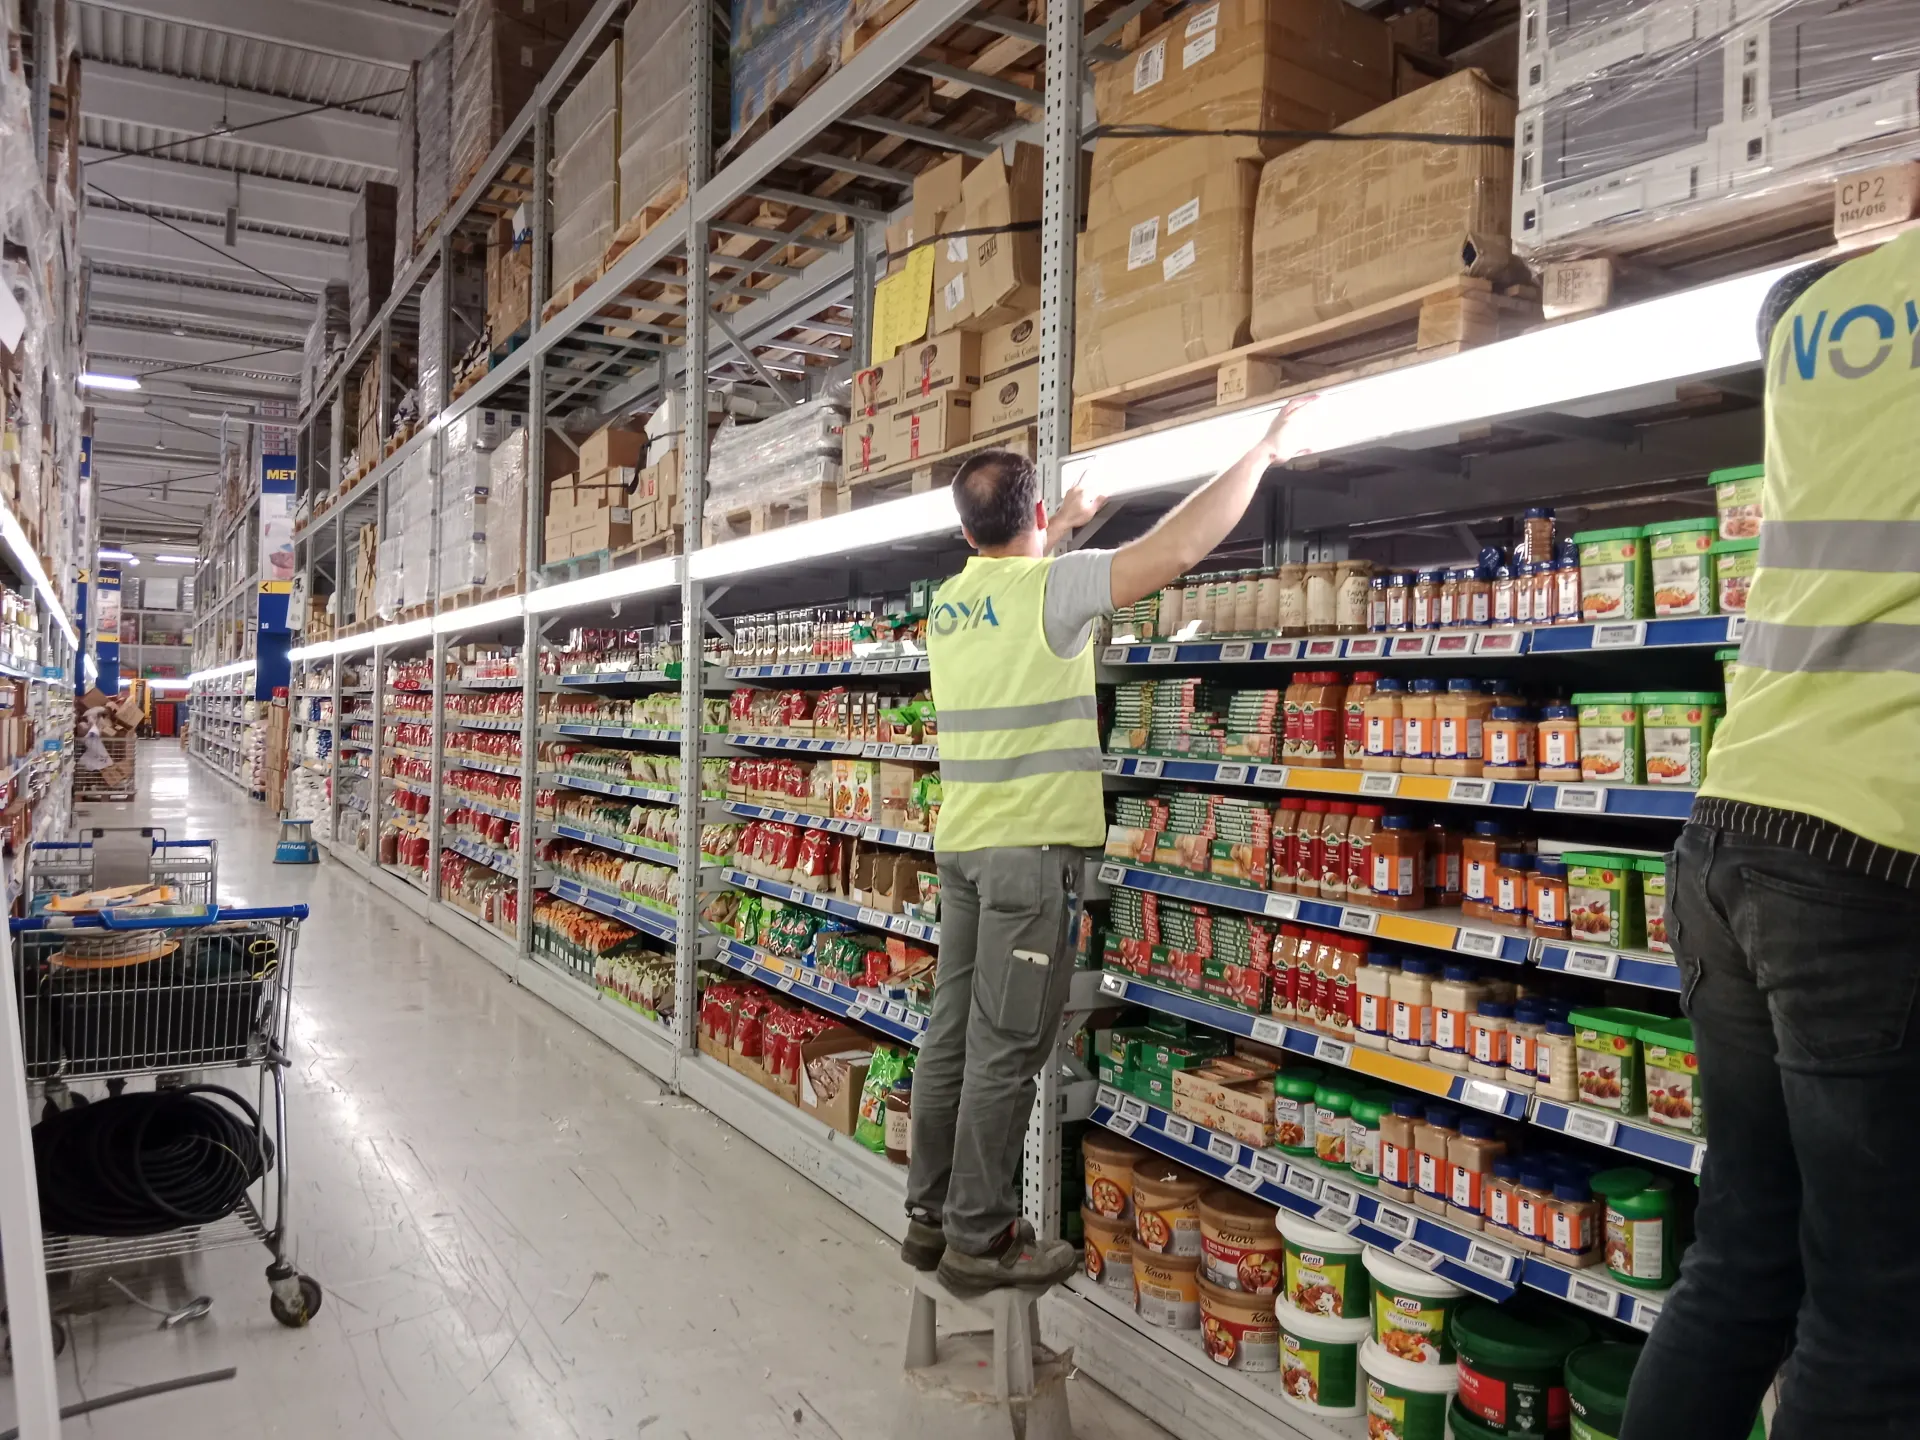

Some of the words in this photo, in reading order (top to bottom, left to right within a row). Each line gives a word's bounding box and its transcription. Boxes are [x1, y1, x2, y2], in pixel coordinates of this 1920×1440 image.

[1317, 1110, 1332, 1119] Kent
[1216, 1228, 1256, 1245] Knorr
[1302, 1254, 1322, 1264] Kent
[1144, 1264, 1173, 1281] Knorr
[1396, 1299, 1418, 1310] Kent
[1284, 1335, 1298, 1347] Kent
